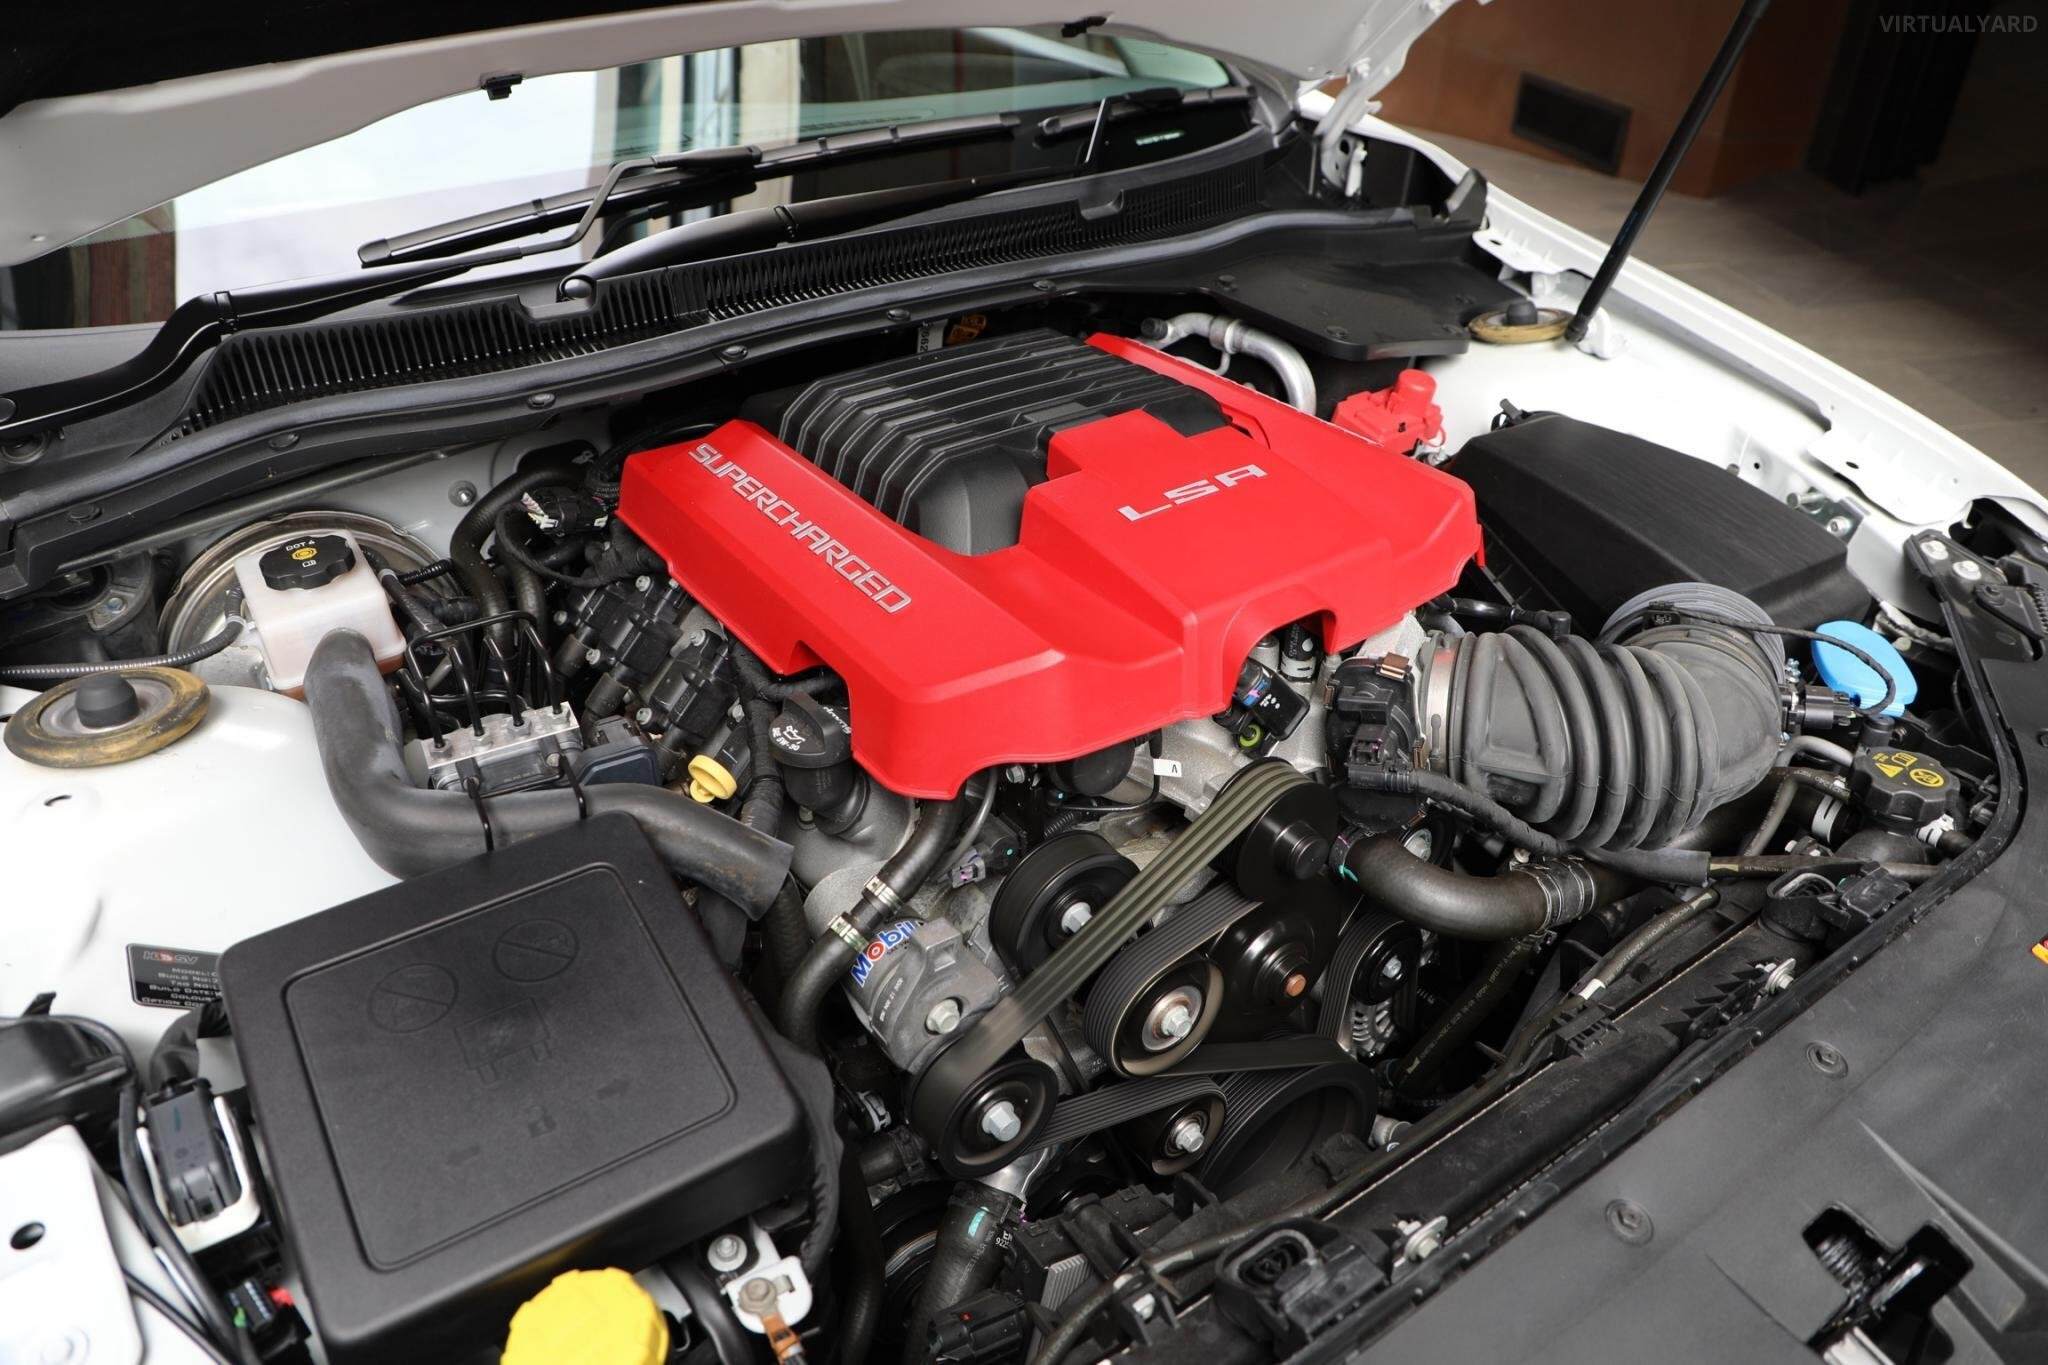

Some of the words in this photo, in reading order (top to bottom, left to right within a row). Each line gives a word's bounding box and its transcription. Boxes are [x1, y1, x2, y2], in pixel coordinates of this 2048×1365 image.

[1117, 464, 1268, 522] LSA
[286, 541, 306, 551] DOT
[688, 443, 912, 614] SUPERCHARGED
[850, 920, 917, 988] Mobil
